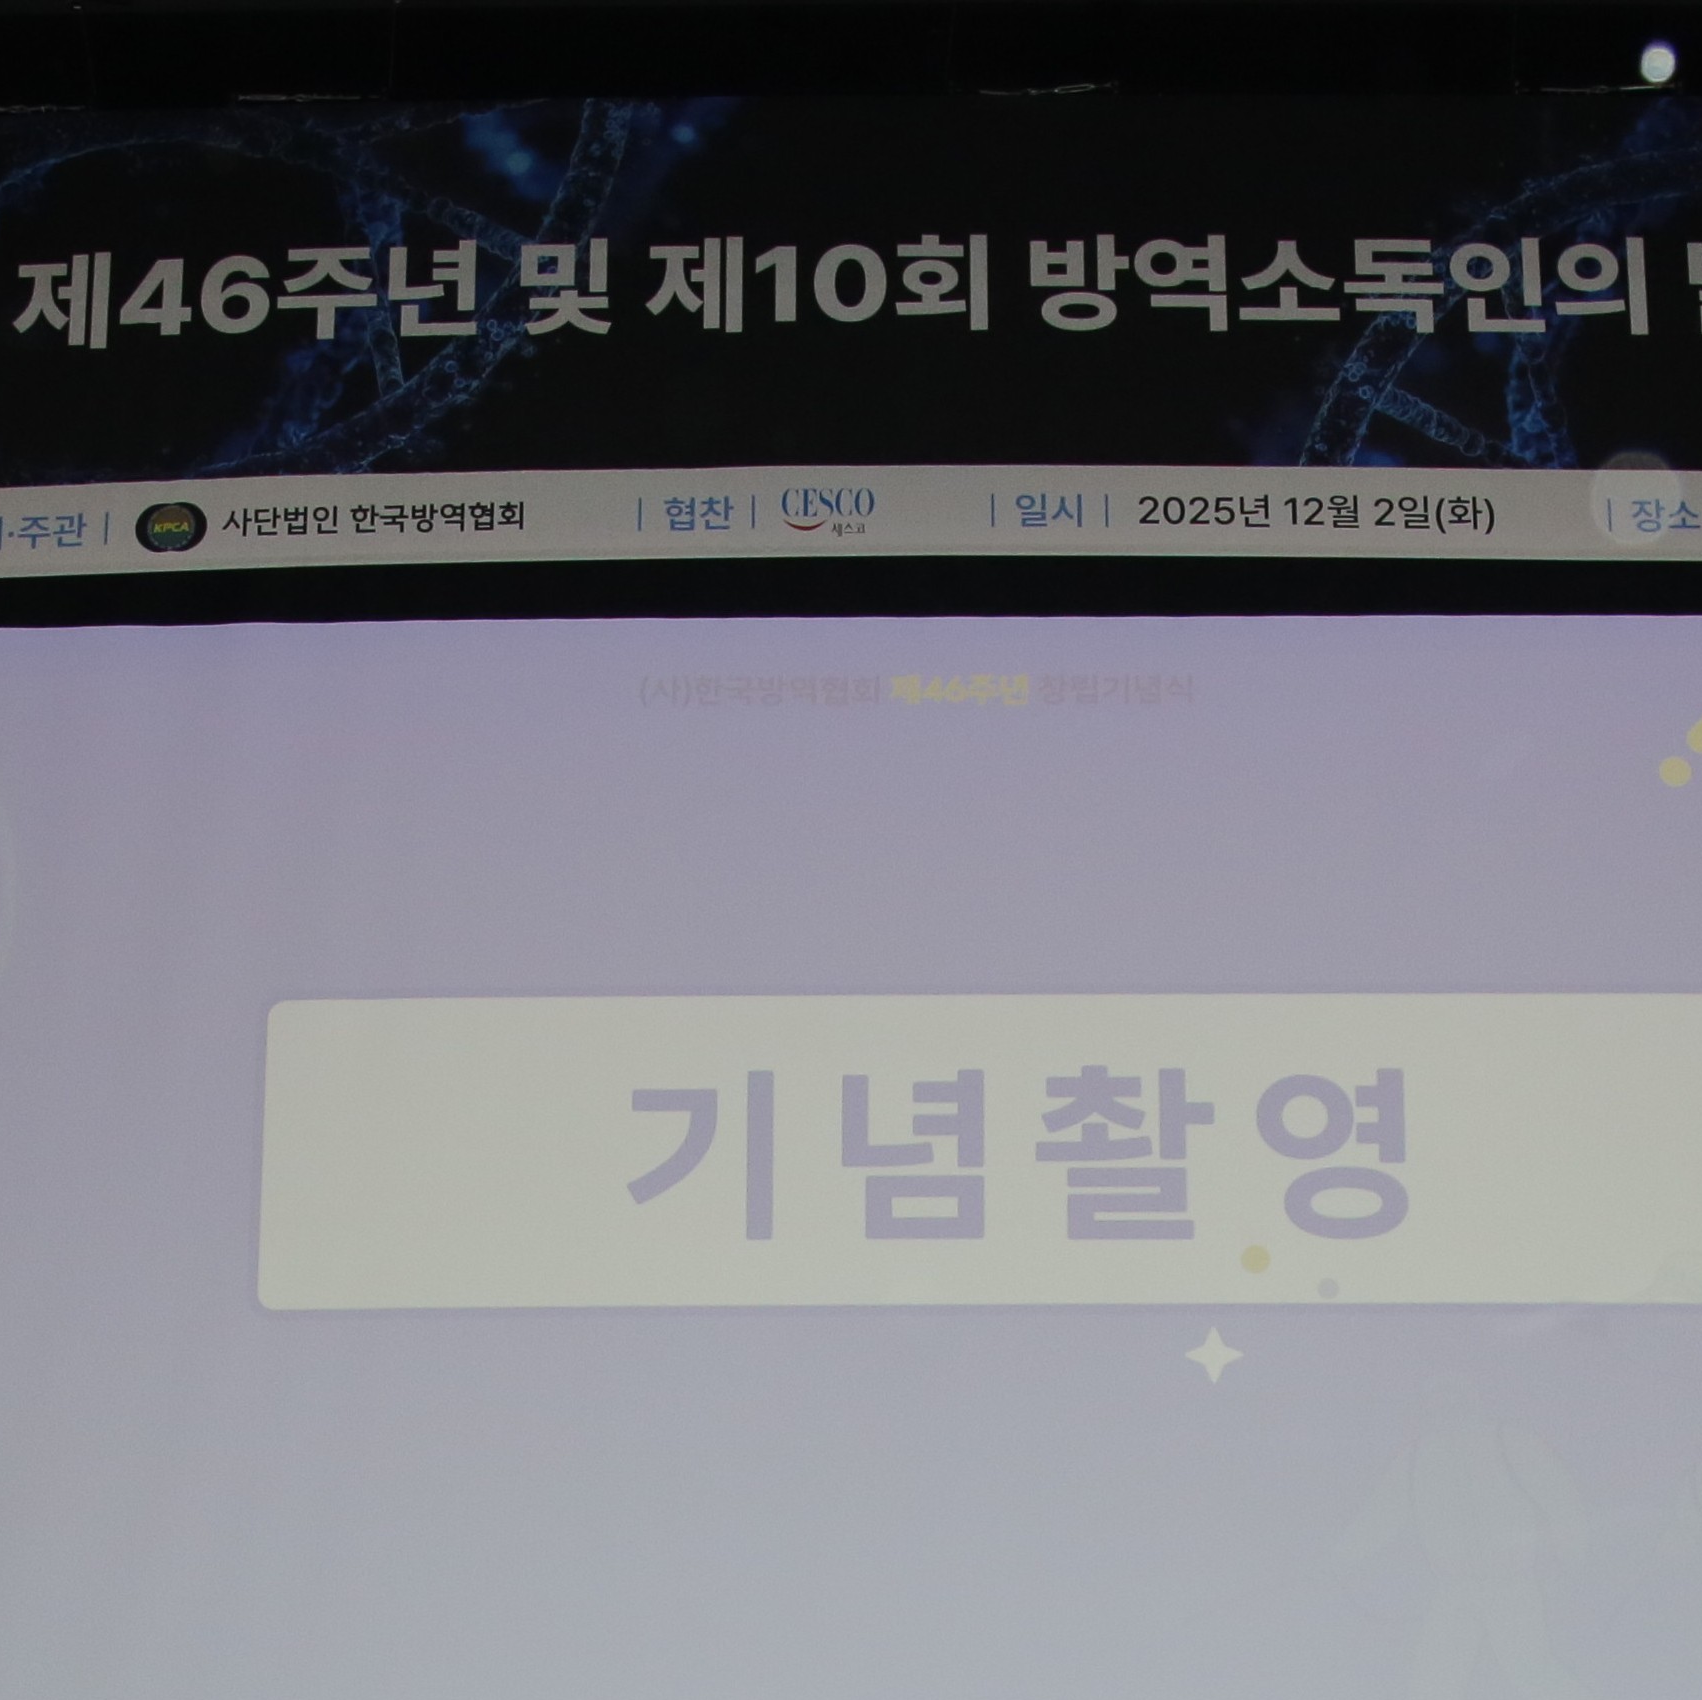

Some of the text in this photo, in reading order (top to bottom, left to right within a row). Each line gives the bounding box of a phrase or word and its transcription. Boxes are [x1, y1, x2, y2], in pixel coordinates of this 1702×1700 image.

[13, 242, 478, 351] 제46주년
[519, 238, 613, 337] 및
[645, 234, 989, 335] 제10회
[1029, 234, 1650, 337] 방역소독인의
[222, 501, 527, 539] 사단법인 한국방역협회
[663, 495, 735, 535] 협찬
[781, 487, 876, 517] CESCO
[1013, 494, 1087, 530] 일시
[1138, 494, 1497, 537] 2025년 12월 2일(화)
[1630, 498, 1702, 535] 장소
[153, 521, 189, 534] KPCA
[831, 522, 867, 537] 세스코
[638, 674, 881, 706] (사)한국방역협회
[891, 674, 1030, 705] 제46주년
[626, 1064, 1410, 1242] 기념촬영
